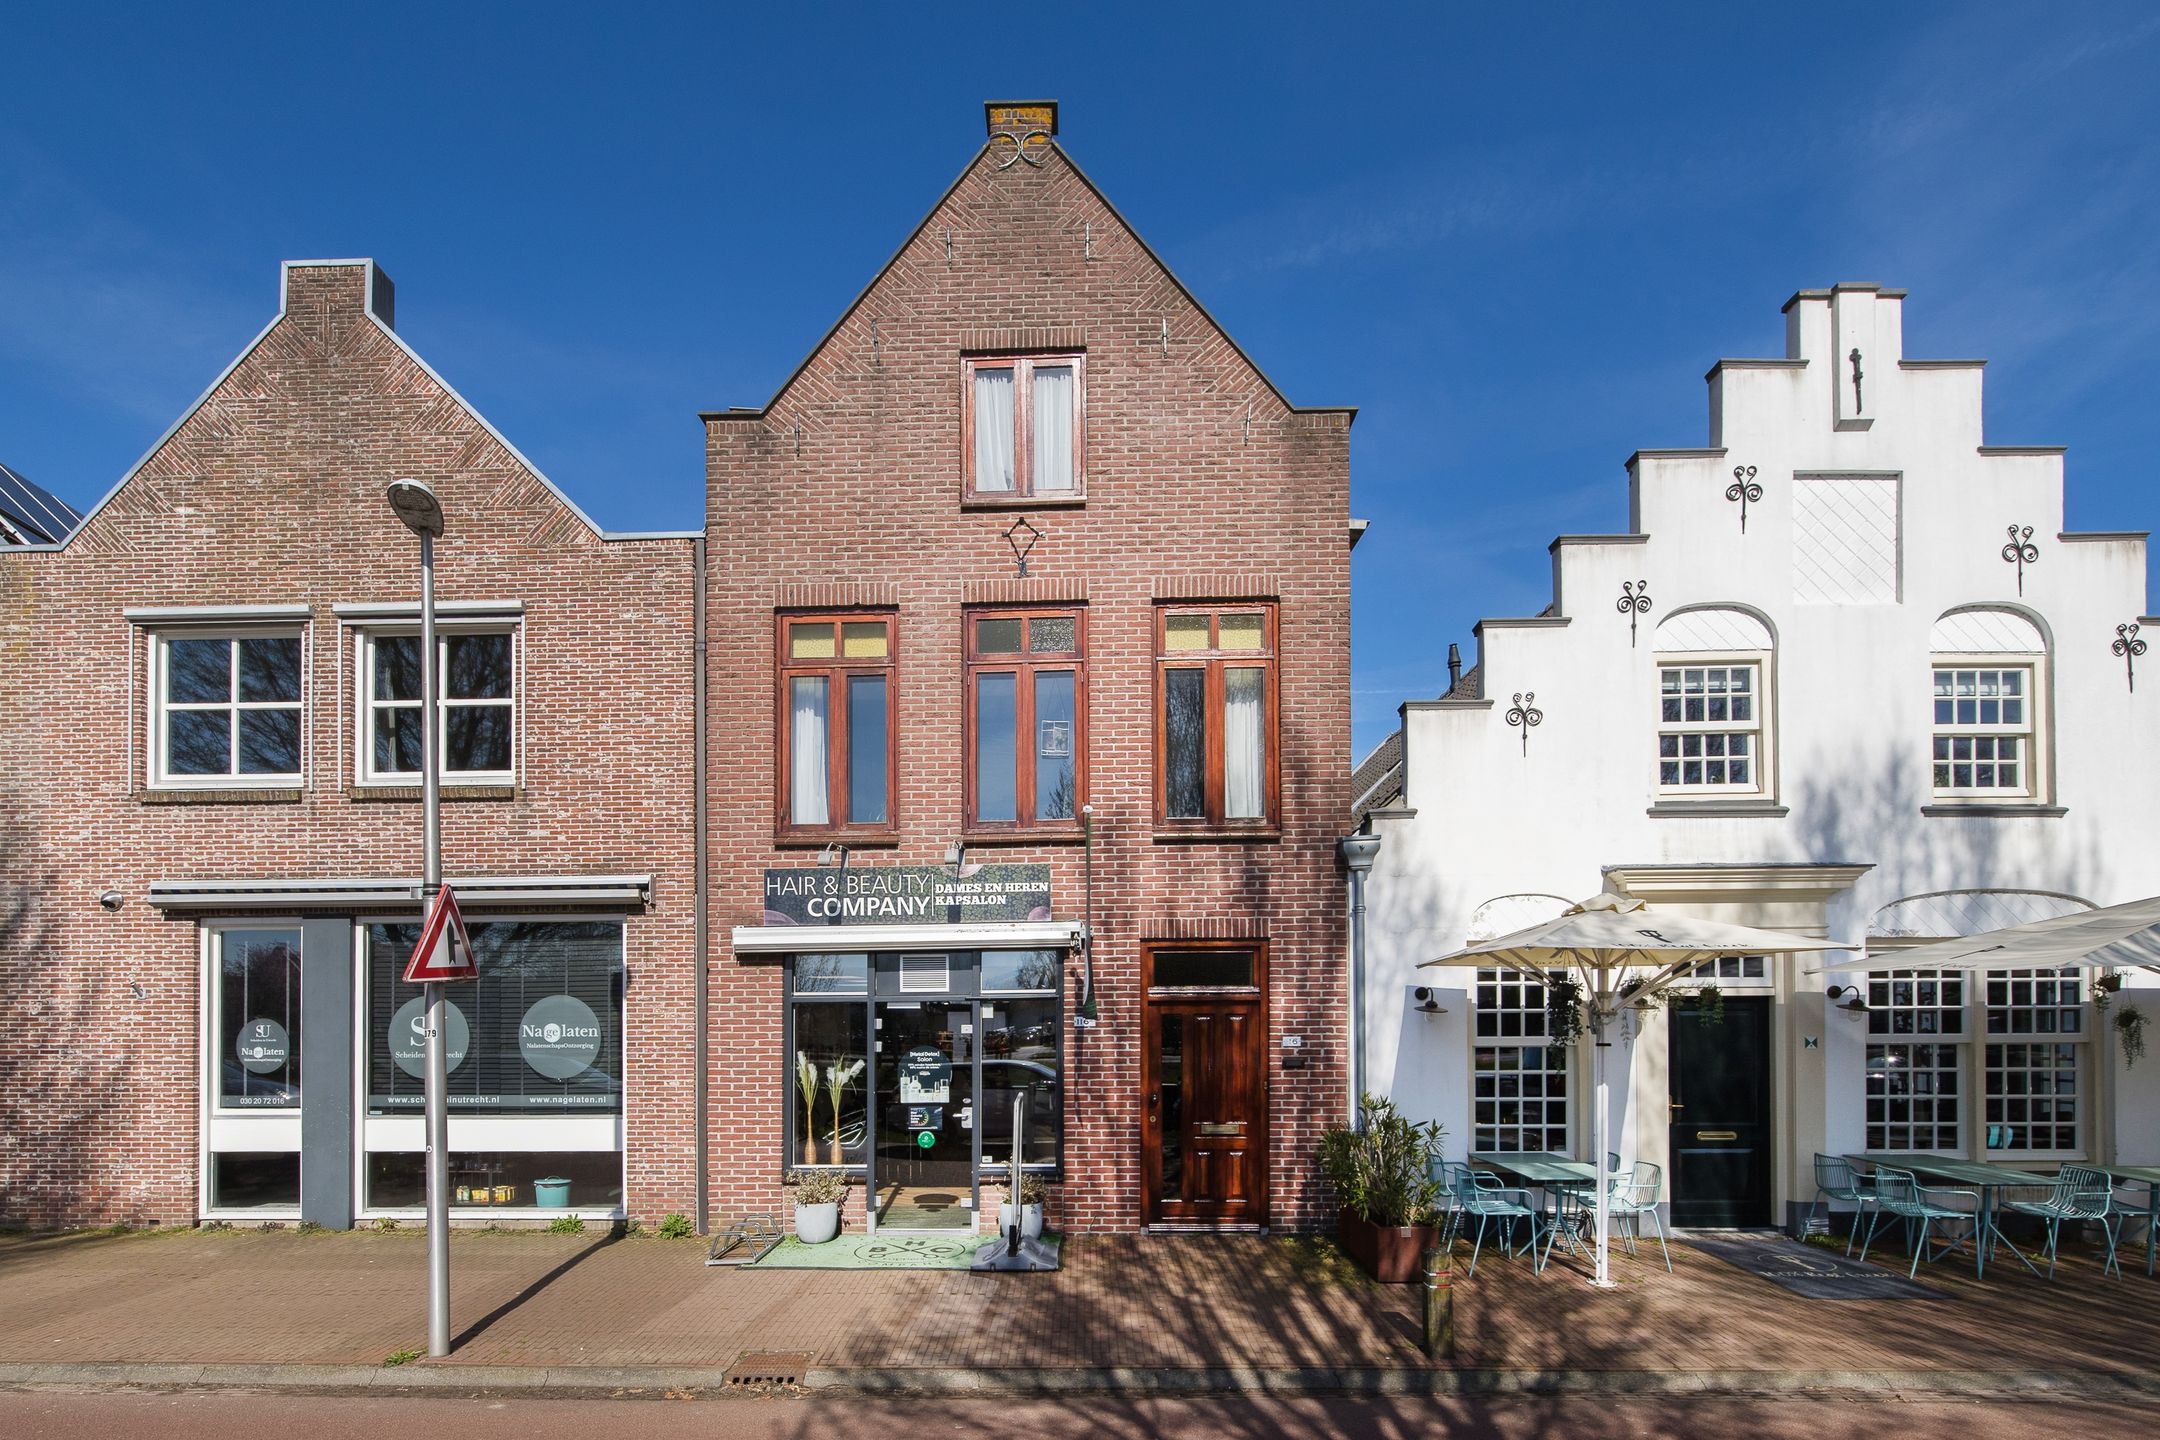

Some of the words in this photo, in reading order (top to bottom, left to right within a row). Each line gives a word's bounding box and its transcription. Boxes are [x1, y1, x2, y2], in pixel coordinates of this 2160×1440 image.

[766, 876, 816, 895] HAIR
[823, 875, 839, 895] &
[847, 874, 930, 894] BEAUTY
[935, 883, 982, 893] DAMES
[984, 882, 1002, 892] EN
[1005, 882, 1049, 892] HEREN
[935, 895, 1007, 906] KAPSALON
[807, 896, 930, 917] COMPANY
[522, 1024, 599, 1039] Nagelaten
[241, 1047, 285, 1057] Nalaten
[395, 1051, 426, 1059] Scheiden
[529, 1096, 607, 1104] www.nagelaten.nl
